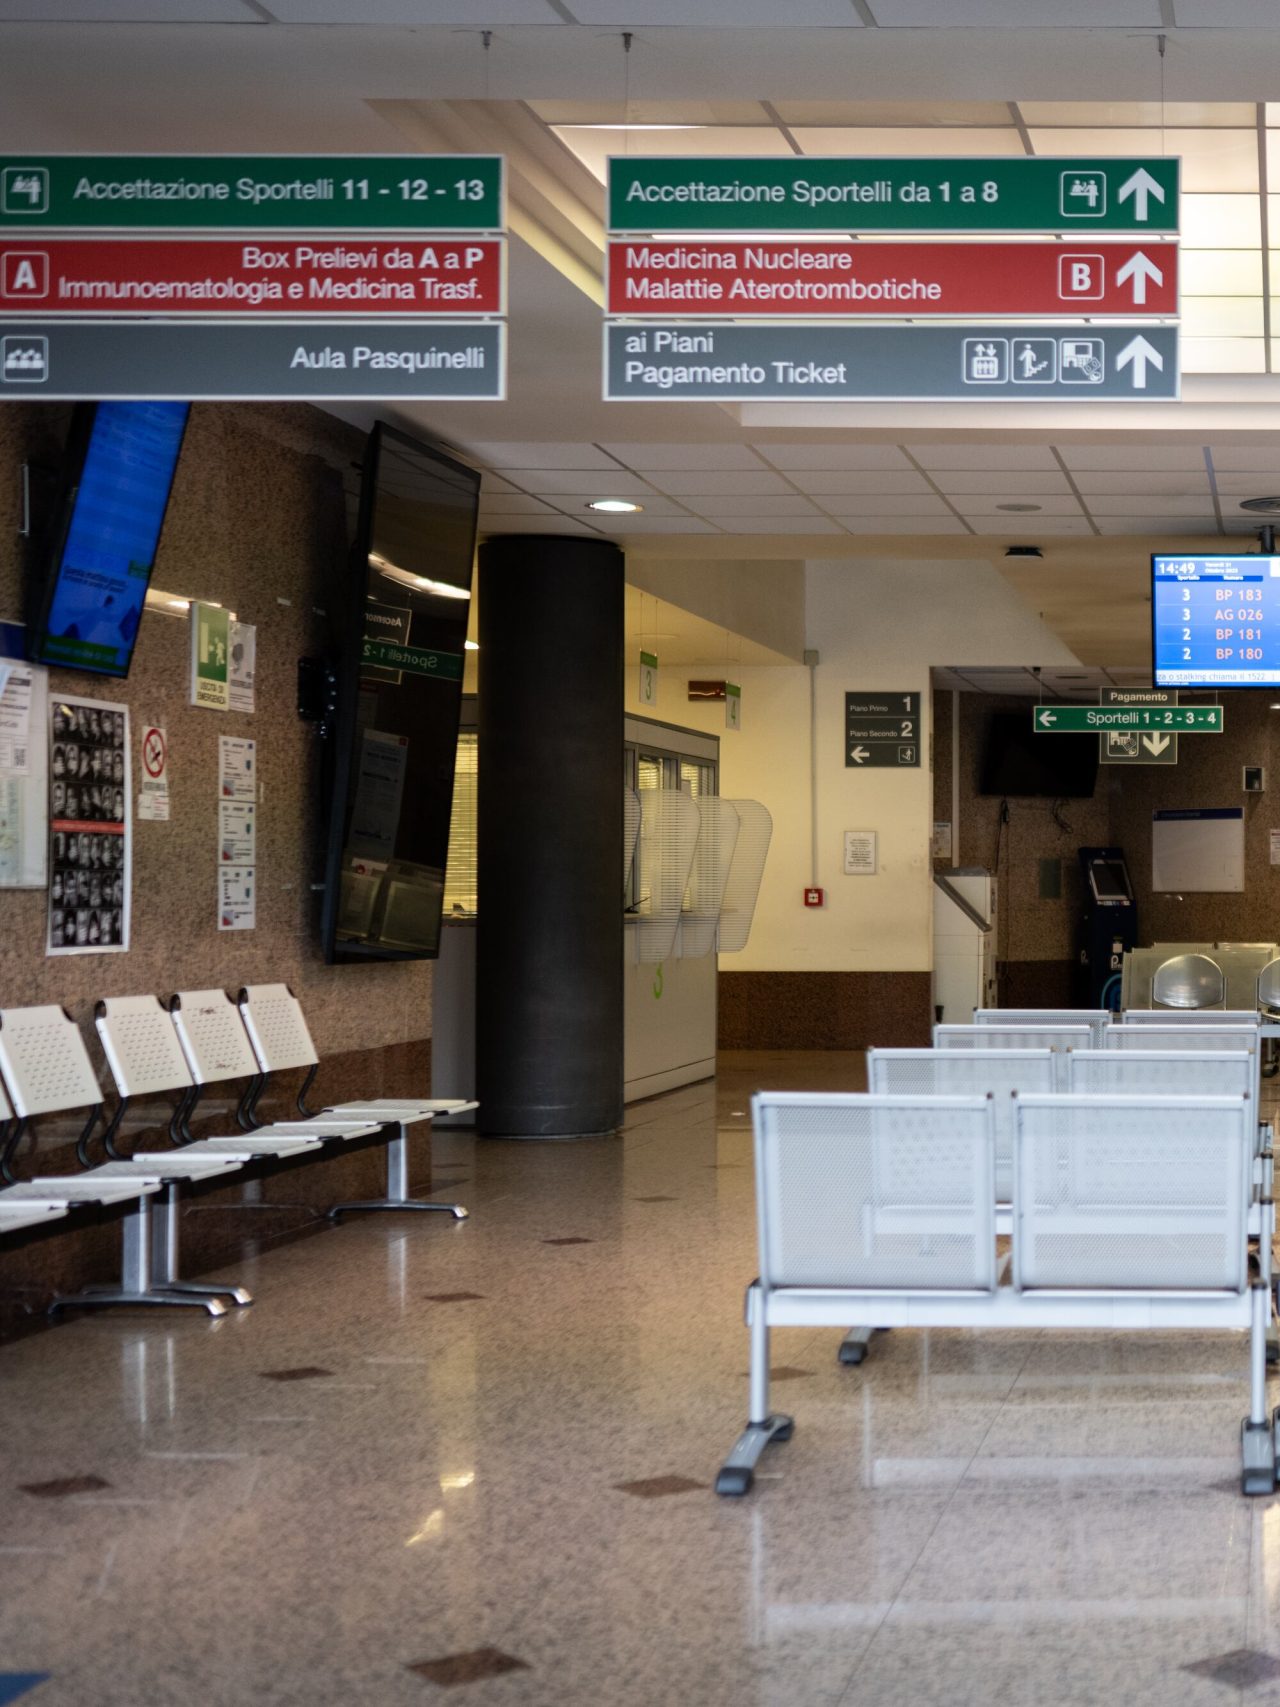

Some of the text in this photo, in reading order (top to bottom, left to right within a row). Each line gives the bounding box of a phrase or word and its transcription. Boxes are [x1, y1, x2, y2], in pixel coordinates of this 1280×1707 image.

[74, 178, 229, 199] Accettazione
[237, 178, 333, 204] Sportelli
[342, 180, 368, 199] 11
[399, 179, 428, 200] 12
[455, 180, 484, 200] 13
[627, 181, 998, 207] Accettazione Sportelli da 1 a 8
[243, 247, 483, 269] Box Prelievi da A a P
[627, 248, 852, 269] Medicina Nucleare
[14, 261, 36, 288] A
[1072, 263, 1091, 290] B
[60, 277, 482, 304] Immunoematologia e Medicina Trasf.
[627, 278, 941, 299] Malattie Aterotrombotiche
[626, 332, 713, 352] ai Piani
[290, 347, 484, 373] Aula Pasquinelli
[626, 361, 846, 388] Pagamento Ticket
[1159, 563, 1195, 574] 14:49
[1182, 589, 1262, 601] 3 BP 183
[1182, 609, 1263, 621] 3 AG 026
[1183, 629, 1261, 640] 2 BP 181
[1183, 648, 1263, 660] 2 BP 180
[646, 671, 652, 700] 3
[1176, 673, 1206, 681] stalking
[903, 696, 911, 711] 1
[1111, 693, 1167, 702] Pagamento
[901, 721, 912, 737] 2
[1087, 712, 1138, 726] Sportelli
[1144, 713, 1149, 723] 1
[1164, 713, 1173, 723] 2
[1186, 713, 1194, 723] 3
[1207, 713, 1216, 723] 4
